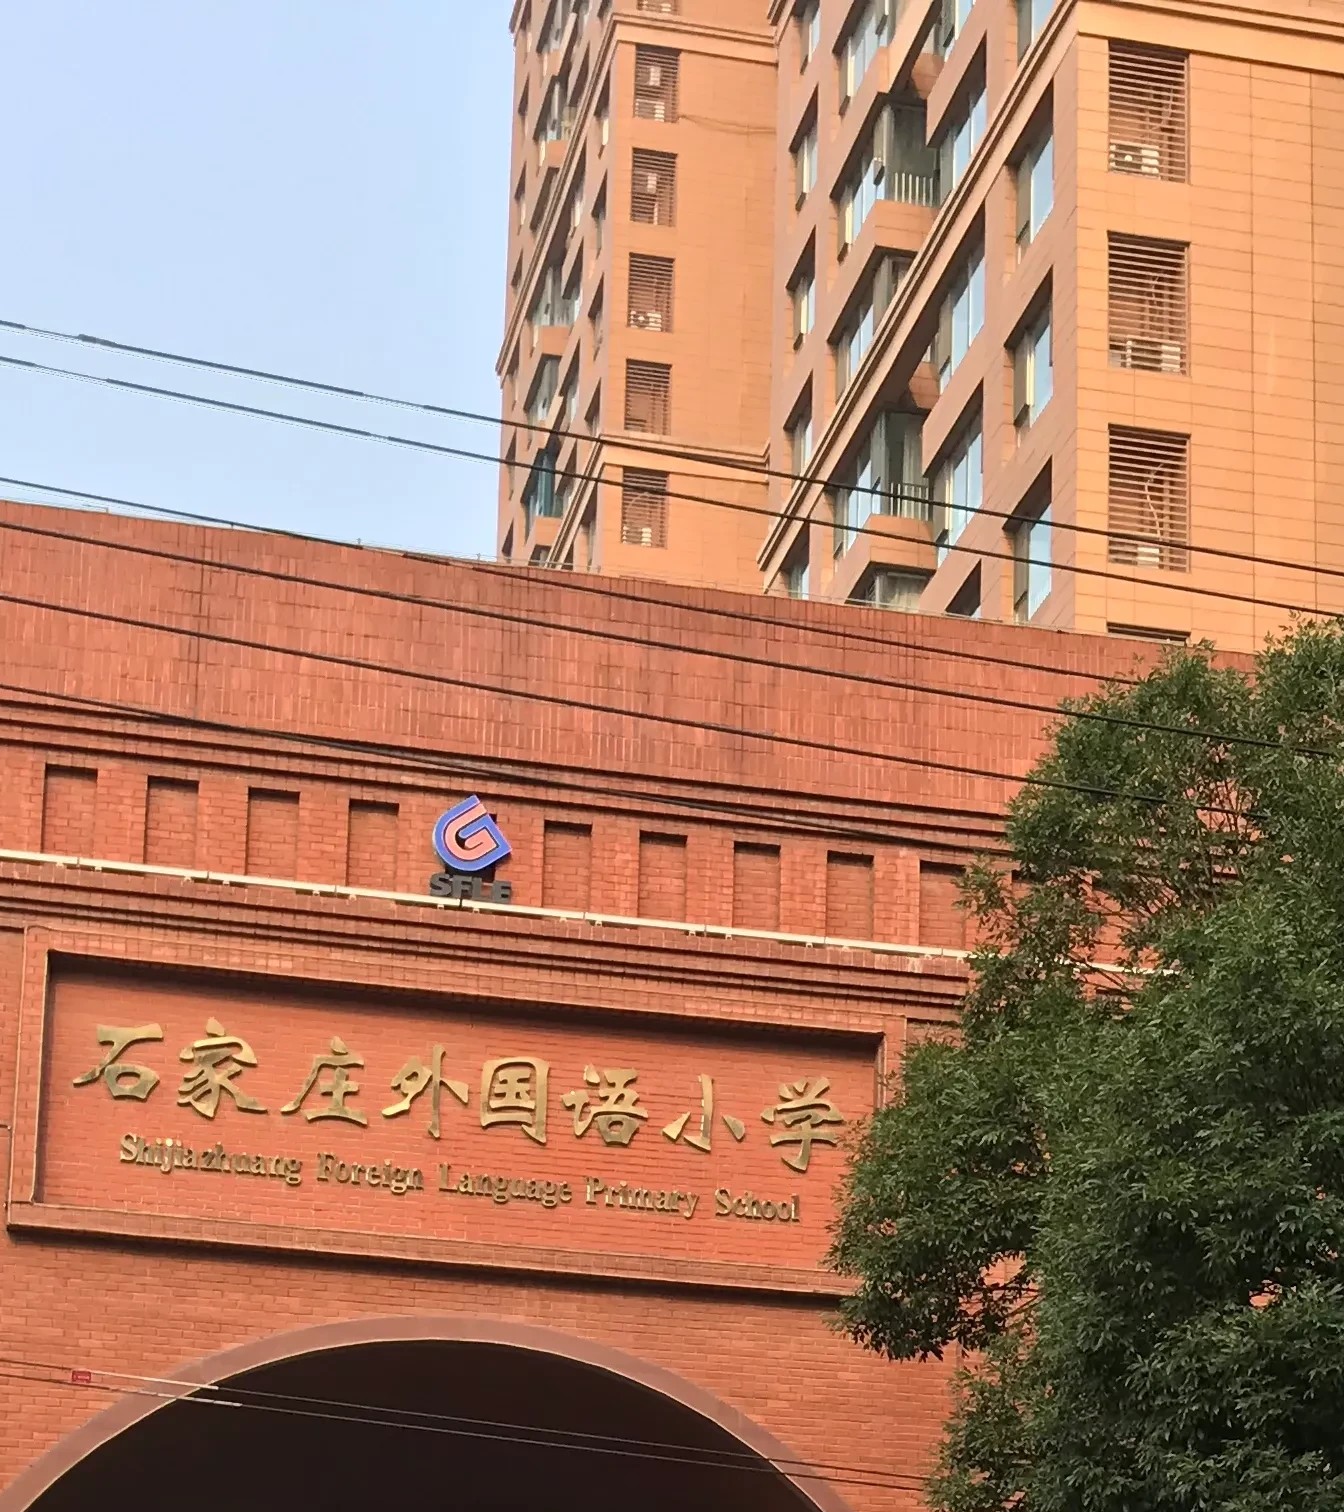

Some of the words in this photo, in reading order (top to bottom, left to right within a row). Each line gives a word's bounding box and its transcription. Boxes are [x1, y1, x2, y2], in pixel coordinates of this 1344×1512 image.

[429, 872, 512, 905] SFLE
[72, 1017, 847, 1172] 石家庄外国语小学
[119, 1133, 303, 1186] Shijiazhuang
[317, 1151, 425, 1195] Foreign
[438, 1161, 573, 1209] Language
[585, 1175, 700, 1219] Primary
[713, 1187, 800, 1222] School
